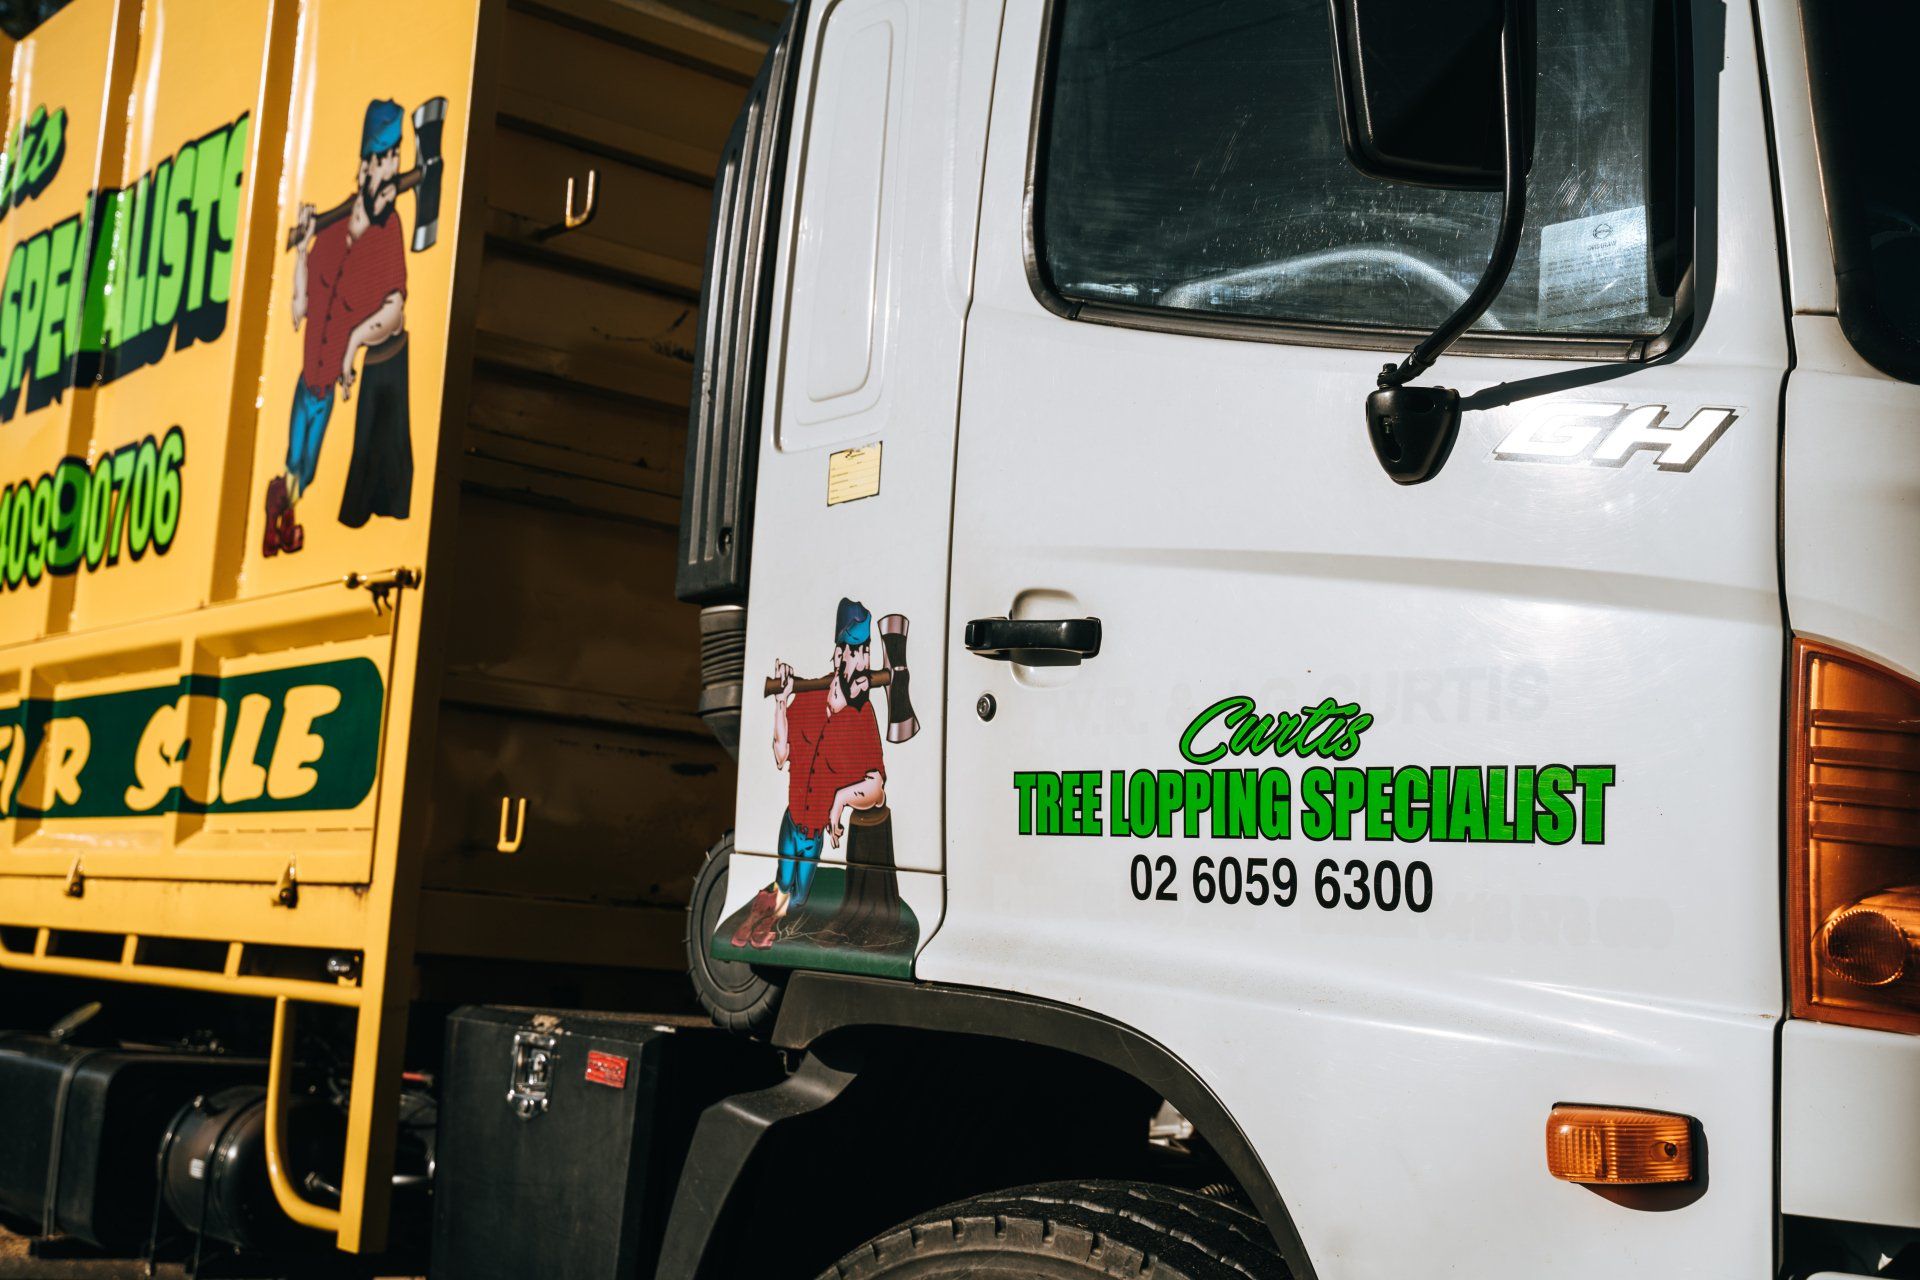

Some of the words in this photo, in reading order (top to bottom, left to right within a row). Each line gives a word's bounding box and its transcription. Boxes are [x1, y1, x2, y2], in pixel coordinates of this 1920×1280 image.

[1492, 402, 1740, 474] GH
[124, 684, 341, 811] SALE
[1179, 695, 1374, 765] Curtis
[1013, 770, 1103, 836] TREE
[1110, 768, 1291, 841] LOPPING
[1300, 763, 1616, 845] SPECIALIST
[1130, 854, 1178, 901] 02
[1192, 855, 1297, 907] 6059
[1314, 858, 1433, 912] 6300
